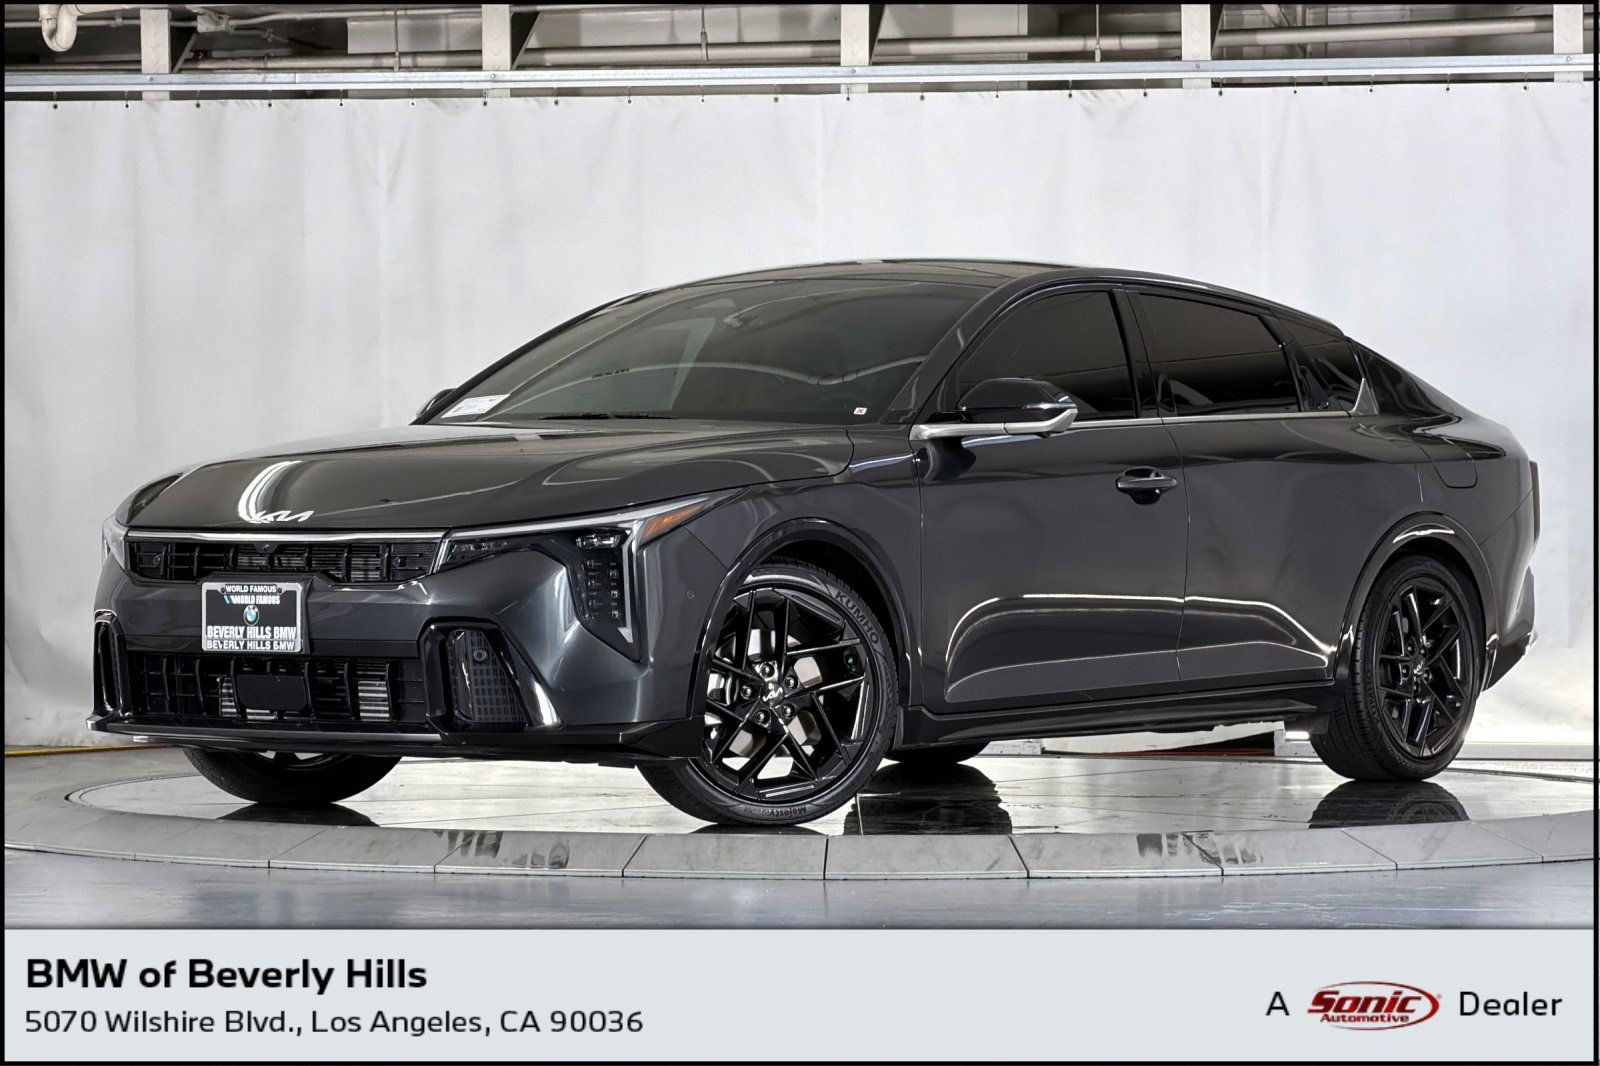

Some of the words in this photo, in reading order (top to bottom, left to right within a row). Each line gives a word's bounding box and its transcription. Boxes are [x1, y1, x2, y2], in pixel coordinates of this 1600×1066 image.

[225, 585, 248, 593] WORLD
[231, 595, 255, 604] WORLD
[256, 595, 280, 604] FAMOUS
[835, 590, 879, 644] KUMHO
[207, 626, 245, 638] BEVERLY
[247, 627, 271, 639] HILLS
[273, 627, 297, 639] BMW
[207, 640, 245, 650] BEVERLY
[247, 641, 270, 650] HILLS
[273, 641, 295, 650] BMW
